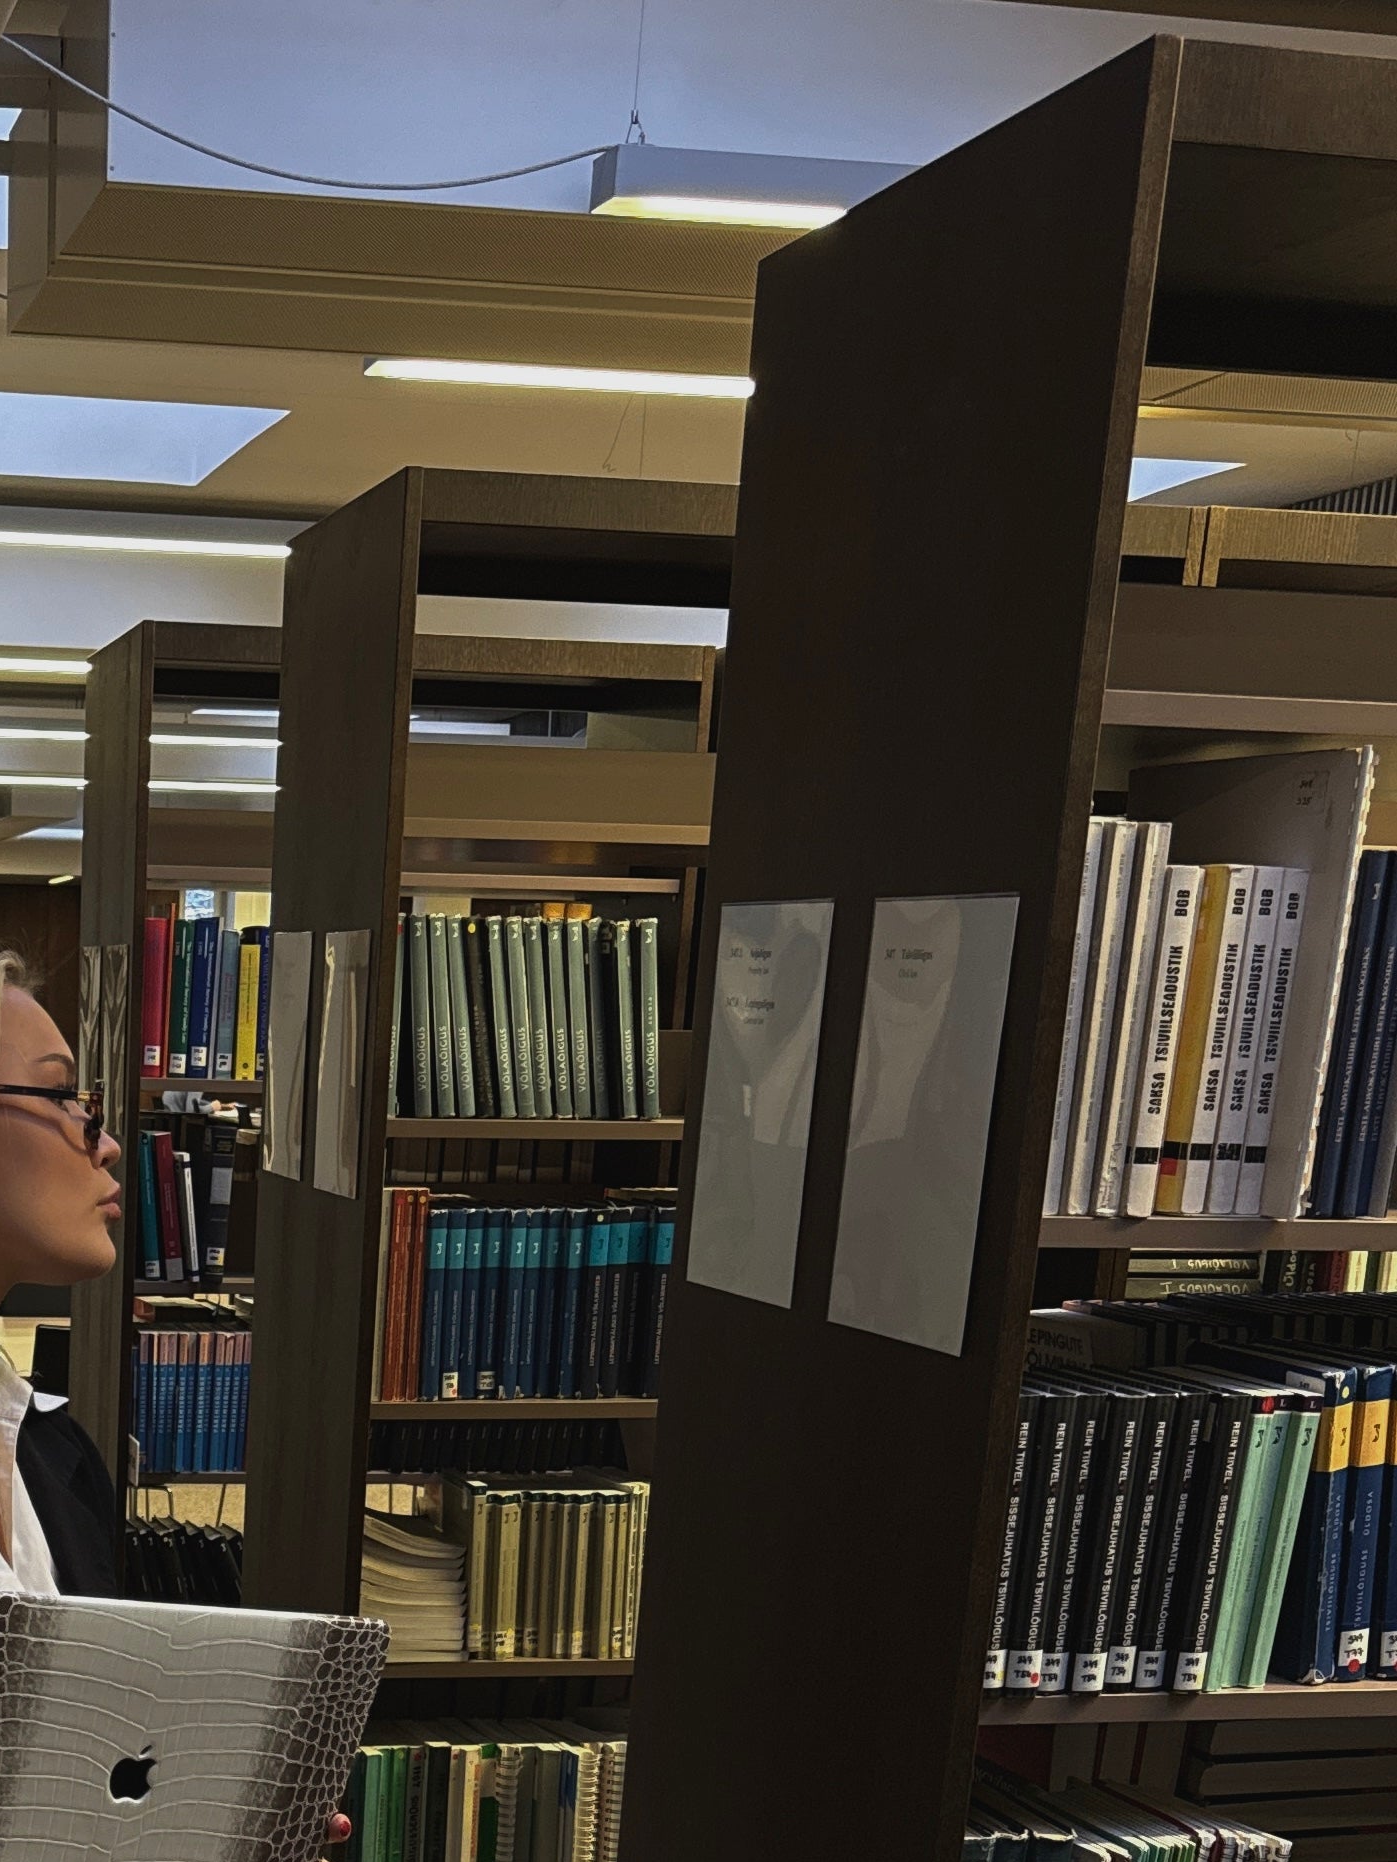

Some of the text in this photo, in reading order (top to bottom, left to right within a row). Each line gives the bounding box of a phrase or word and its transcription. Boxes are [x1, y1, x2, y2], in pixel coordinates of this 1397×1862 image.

[1174, 889, 1190, 917] BGB
[1232, 888, 1246, 916] BGB
[1258, 889, 1274, 916] BGB
[1285, 892, 1301, 920] BGB
[1147, 1073, 1165, 1115] SAKSA
[1203, 1069, 1220, 1112] SAKSA
[1230, 1069, 1248, 1112] SAKSA
[1257, 1072, 1274, 1114] SAKSA
[1017, 1421, 1030, 1449] REIN
[1054, 1422, 1067, 1450] REIN
[1083, 1420, 1096, 1447] REIN
[1123, 1421, 1136, 1448] REIN
[1154, 1421, 1166, 1448] REIN
[1188, 1419, 1200, 1446] REIN
[1229, 1421, 1242, 1448] REIN
[1012, 1450, 1026, 1486] TIIVEL
[1049, 1451, 1062, 1487] TIIVEL
[1078, 1449, 1092, 1483] TIIVEL
[1118, 1449, 1132, 1484] TIIVEL
[1148, 1449, 1162, 1484] TIIVEL
[1182, 1448, 1196, 1482] TIIVEL
[1223, 1449, 1237, 1484] TIIVEL
[990, 1580, 1008, 1650] TSIVIILÕIGUS
[1026, 1580, 1045, 1650] TSIVIILÕIGUS
[1054, 1577, 1073, 1653] TSIVIILÕIGUSE
[1092, 1578, 1112, 1655] TSIVIILÕIGUSE
[1122, 1577, 1141, 1647] TSIVIILÕIGUS
[1154, 1574, 1174, 1651] TSIVIILÕIGUSE
[1194, 1577, 1215, 1653] TSIVIILÕIGUSE
